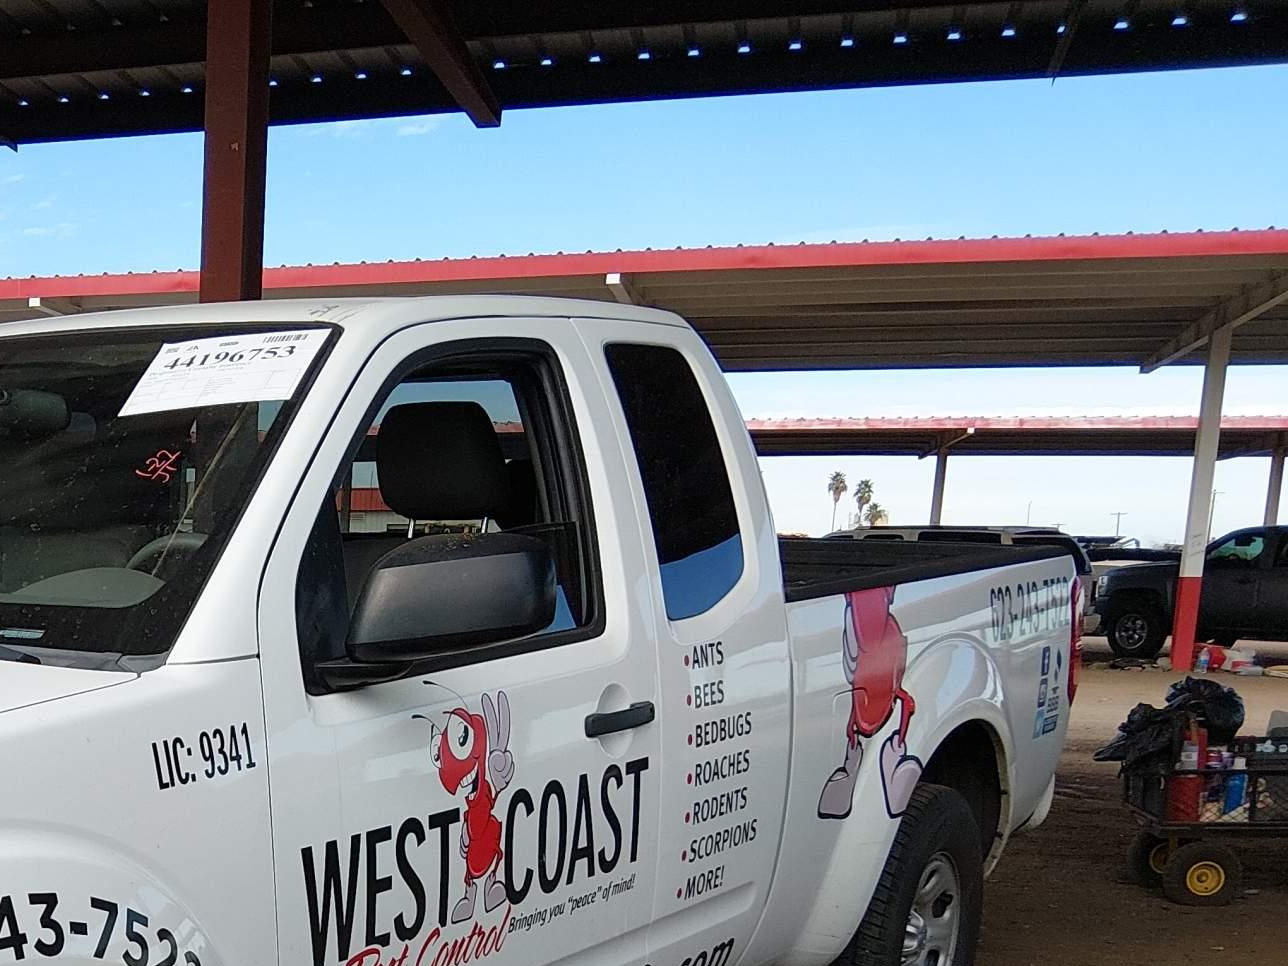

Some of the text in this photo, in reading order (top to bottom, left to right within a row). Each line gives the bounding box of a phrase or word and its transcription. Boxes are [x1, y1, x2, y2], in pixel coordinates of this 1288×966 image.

[163, 345, 297, 370] 44196753
[990, 576, 1070, 642] 623-243-7522
[692, 641, 724, 670] ANTS
[694, 680, 724, 709] BEES
[695, 712, 752, 748] BEDBUGS
[152, 722, 256, 790] LIC: 9341
[694, 749, 750, 787] ROACHES
[692, 787, 748, 825] RODENTS
[504, 757, 649, 905] COAST
[688, 818, 758, 863] SCORPIONS
[684, 865, 725, 900] MORE!
[508, 908, 547, 934] Bringing
[549, 902, 566, 923] you
[602, 881, 613, 901] of
[612, 873, 636, 896] mind!
